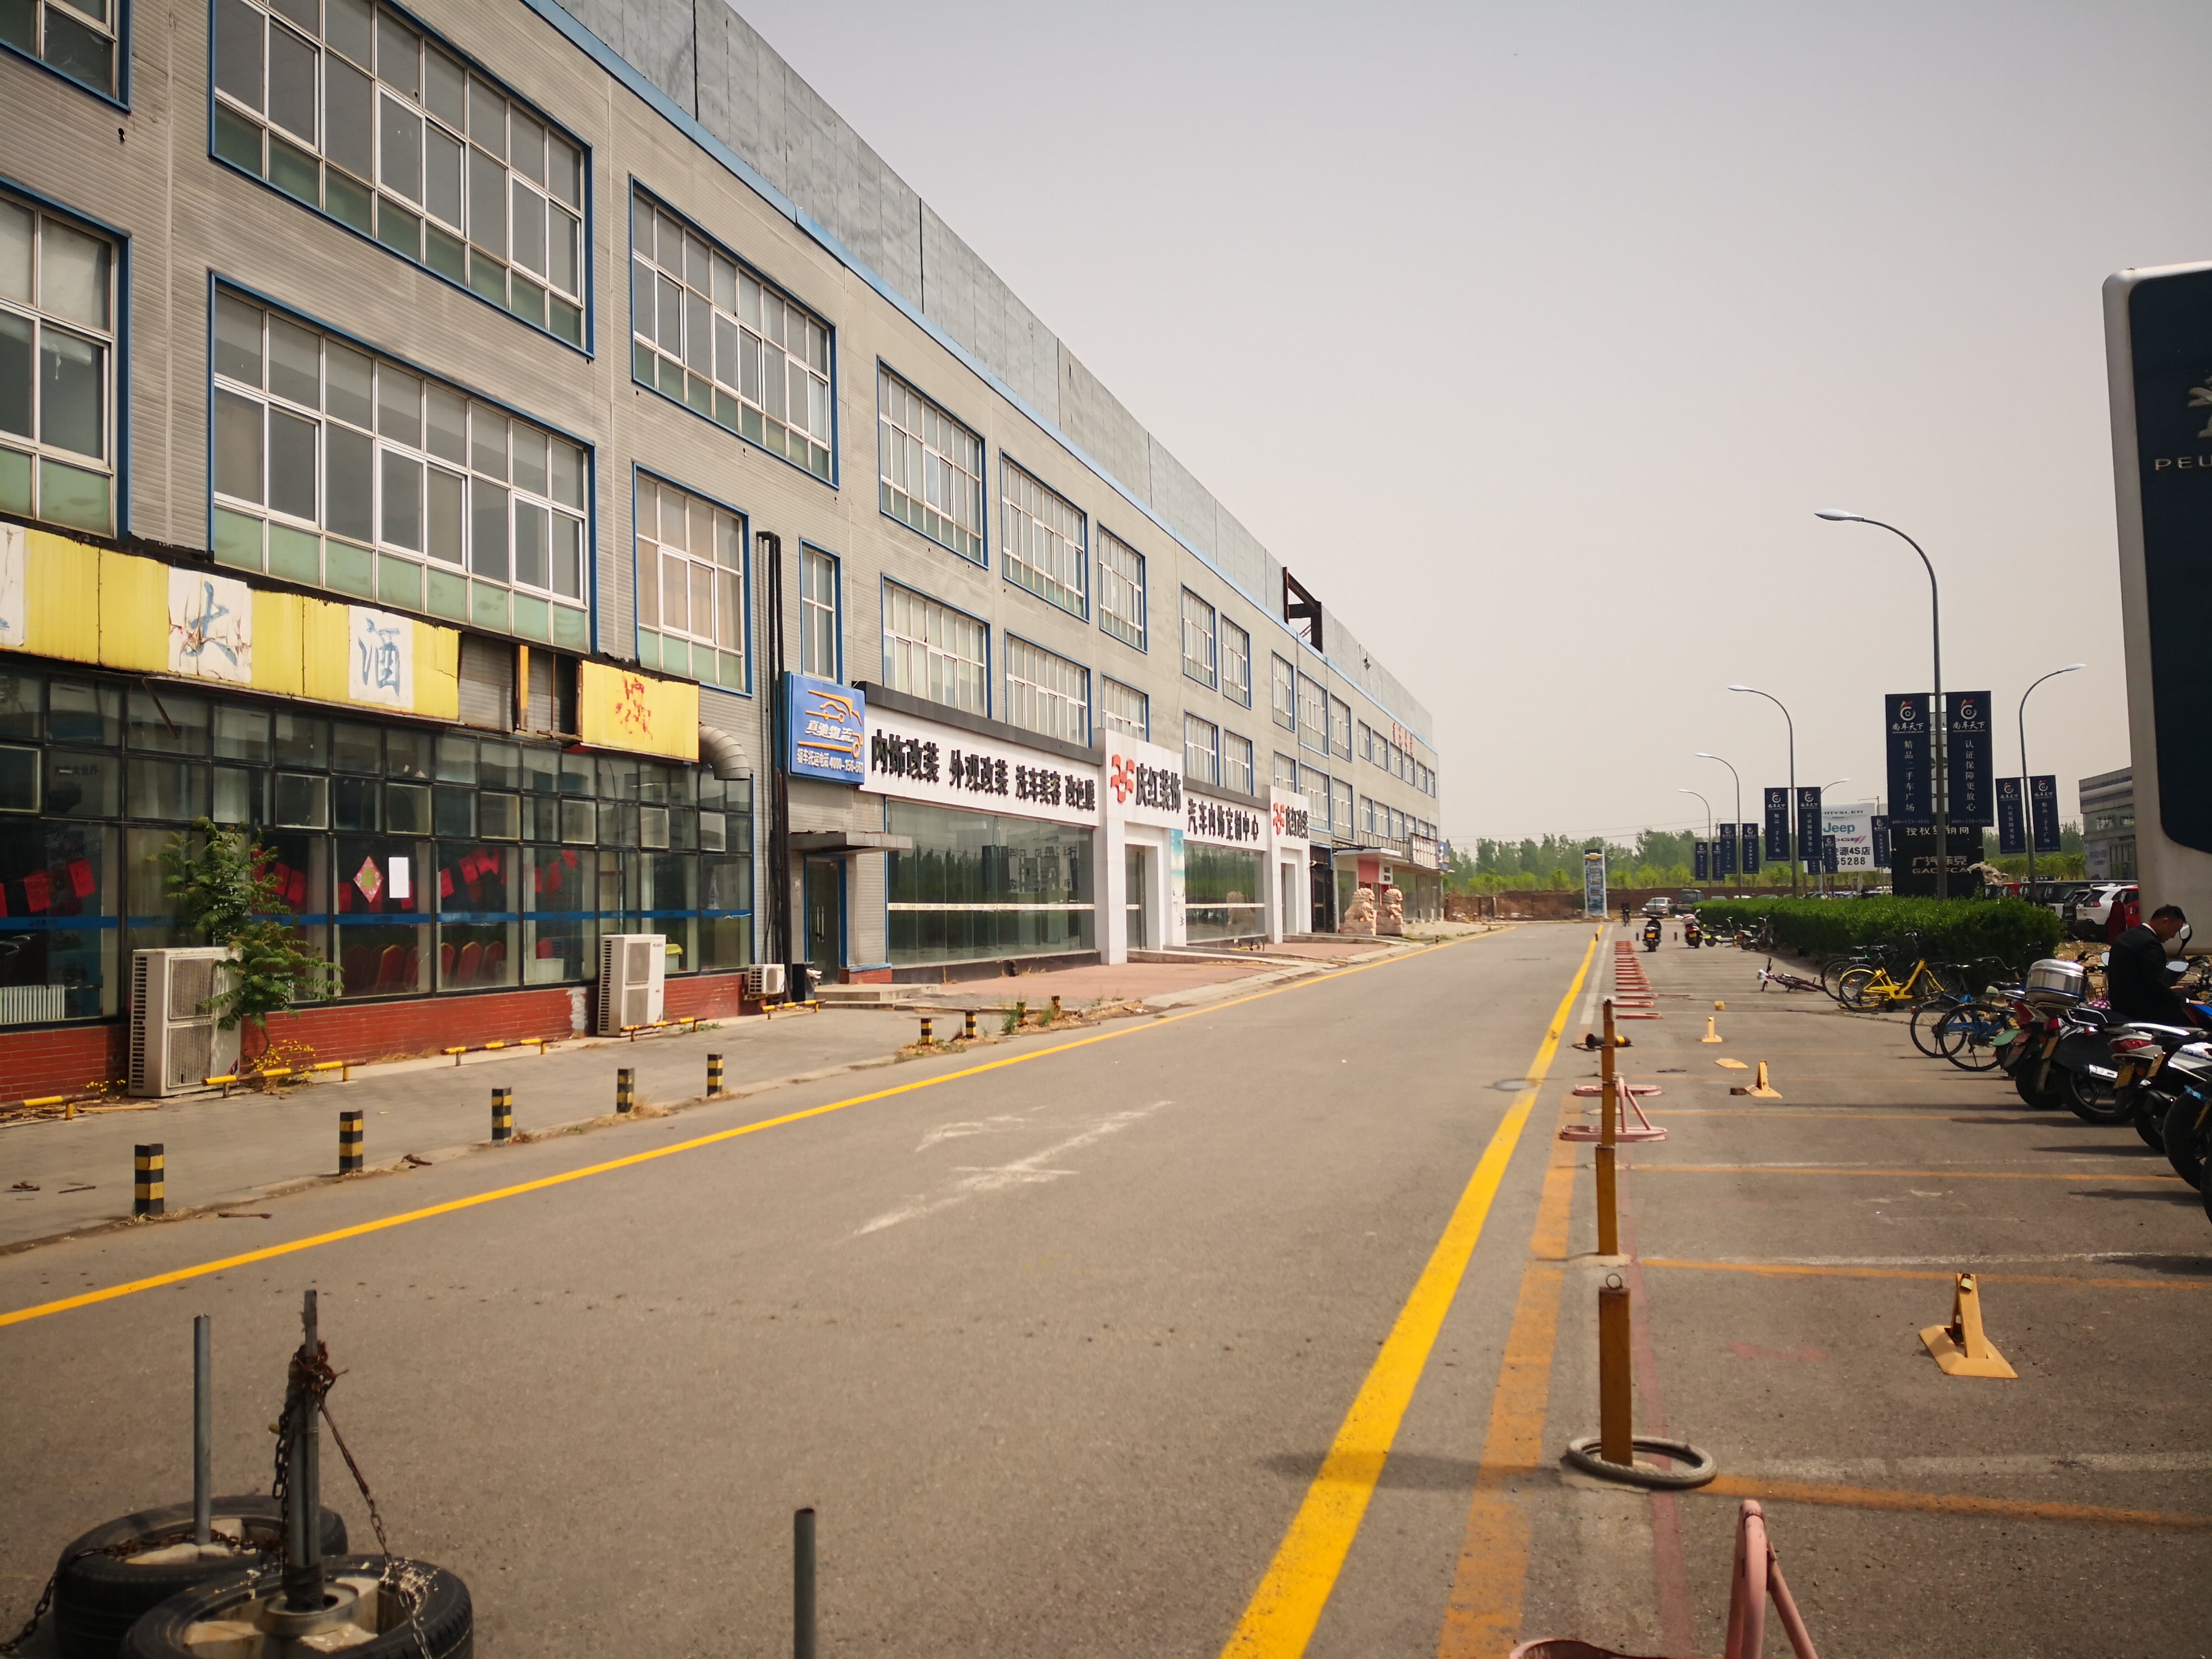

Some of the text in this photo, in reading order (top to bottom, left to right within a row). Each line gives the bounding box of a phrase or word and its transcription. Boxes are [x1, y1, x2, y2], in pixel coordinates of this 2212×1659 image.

[358, 618, 400, 697] 酒
[805, 720, 854, 743] 真驰物流
[871, 729, 1095, 811] 内饰改装 外观改装 洗车美容 改色膜
[1136, 763, 1181, 813] 庆红装饰
[1904, 740, 1915, 812] 精品二手车广场
[1965, 740, 1976, 811] 认证保障更放心
[1187, 792, 1259, 841] 汽车内饰定制中心
[1823, 822, 1855, 835] Jeep
